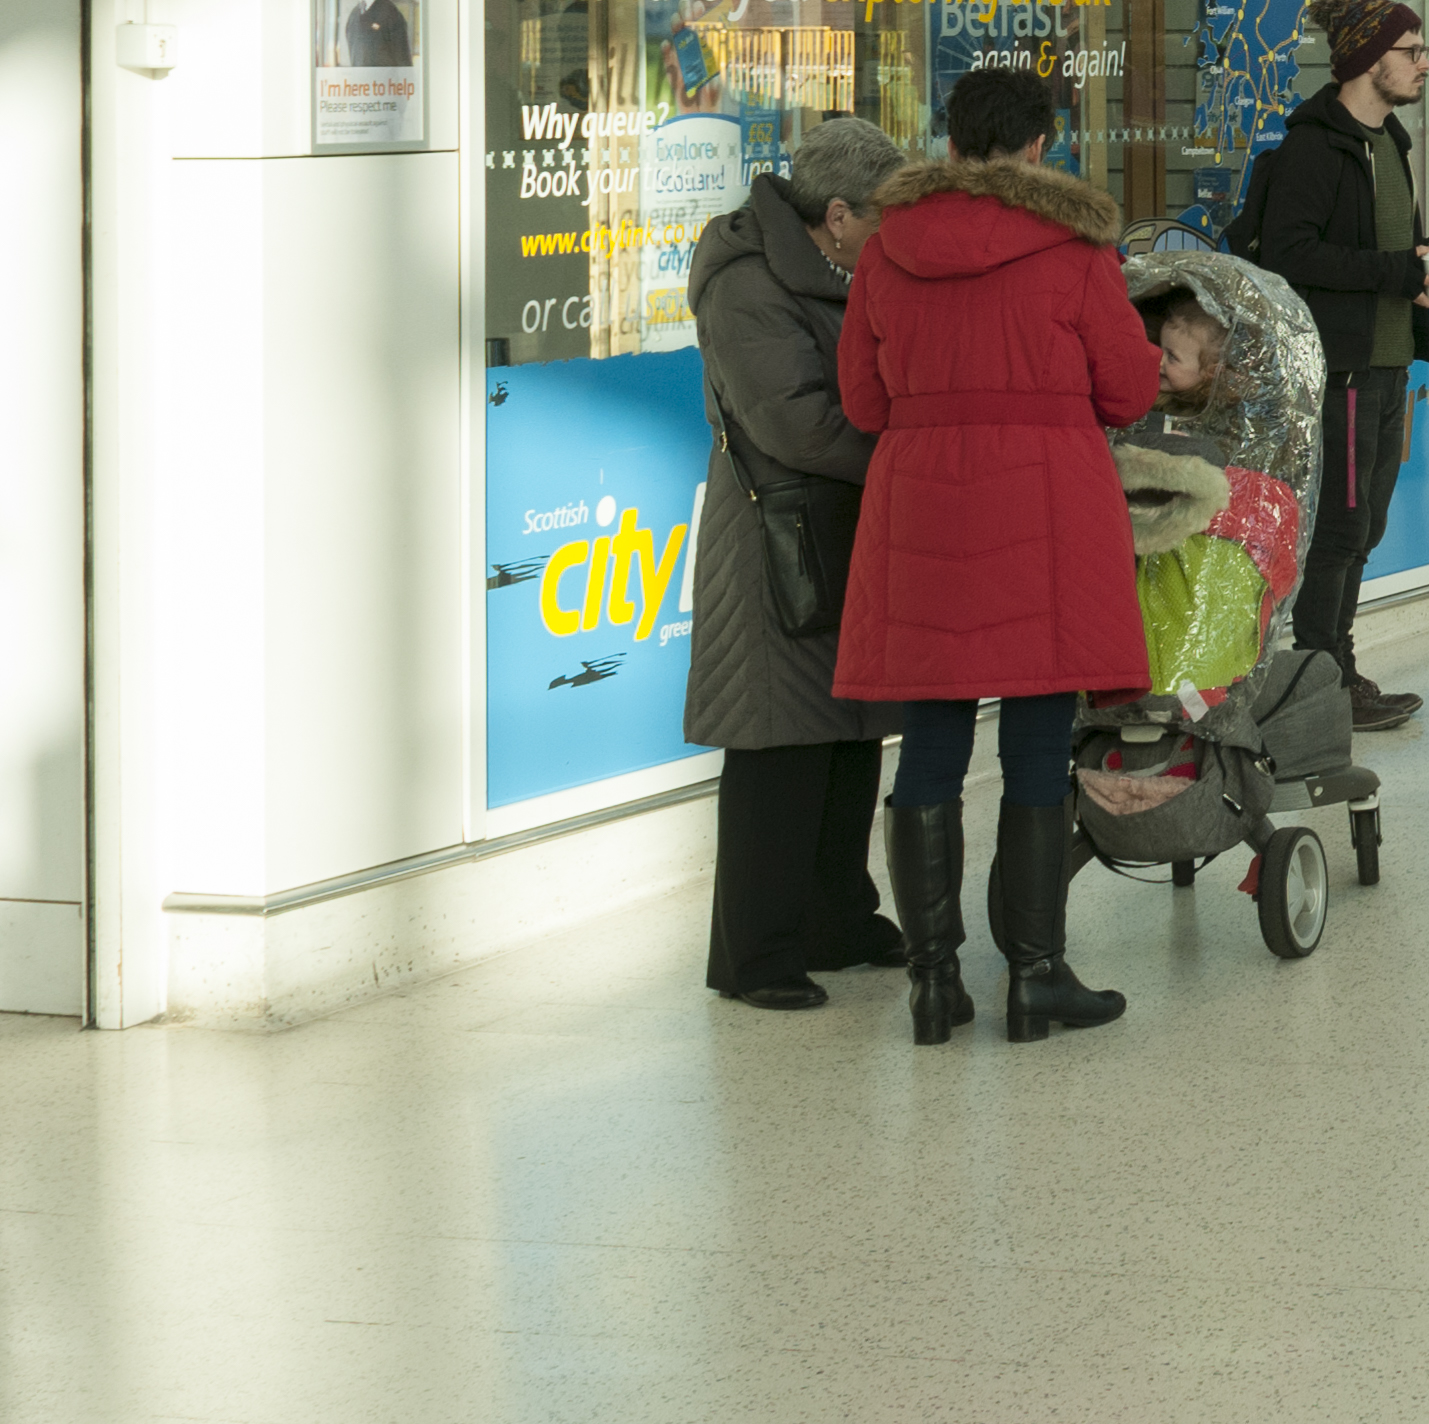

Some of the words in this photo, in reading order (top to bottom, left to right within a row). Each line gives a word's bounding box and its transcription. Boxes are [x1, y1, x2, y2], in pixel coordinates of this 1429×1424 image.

[1037, 41, 1057, 78] &
[1062, 40, 1127, 89] again!
[320, 79, 341, 97] I'm
[343, 79, 370, 97] here
[372, 80, 386, 97] to
[388, 78, 415, 101] help
[320, 100, 347, 113] Please
[349, 101, 381, 114] respect
[382, 101, 397, 112] me
[521, 102, 580, 150] Why
[582, 102, 670, 149] queue?
[748, 123, 774, 143] £62
[656, 136, 714, 162] Explore
[520, 160, 581, 199] Book
[581, 166, 640, 206] your
[521, 298, 556, 334] or
[562, 277, 615, 330] call
[522, 500, 589, 535] Scottish
